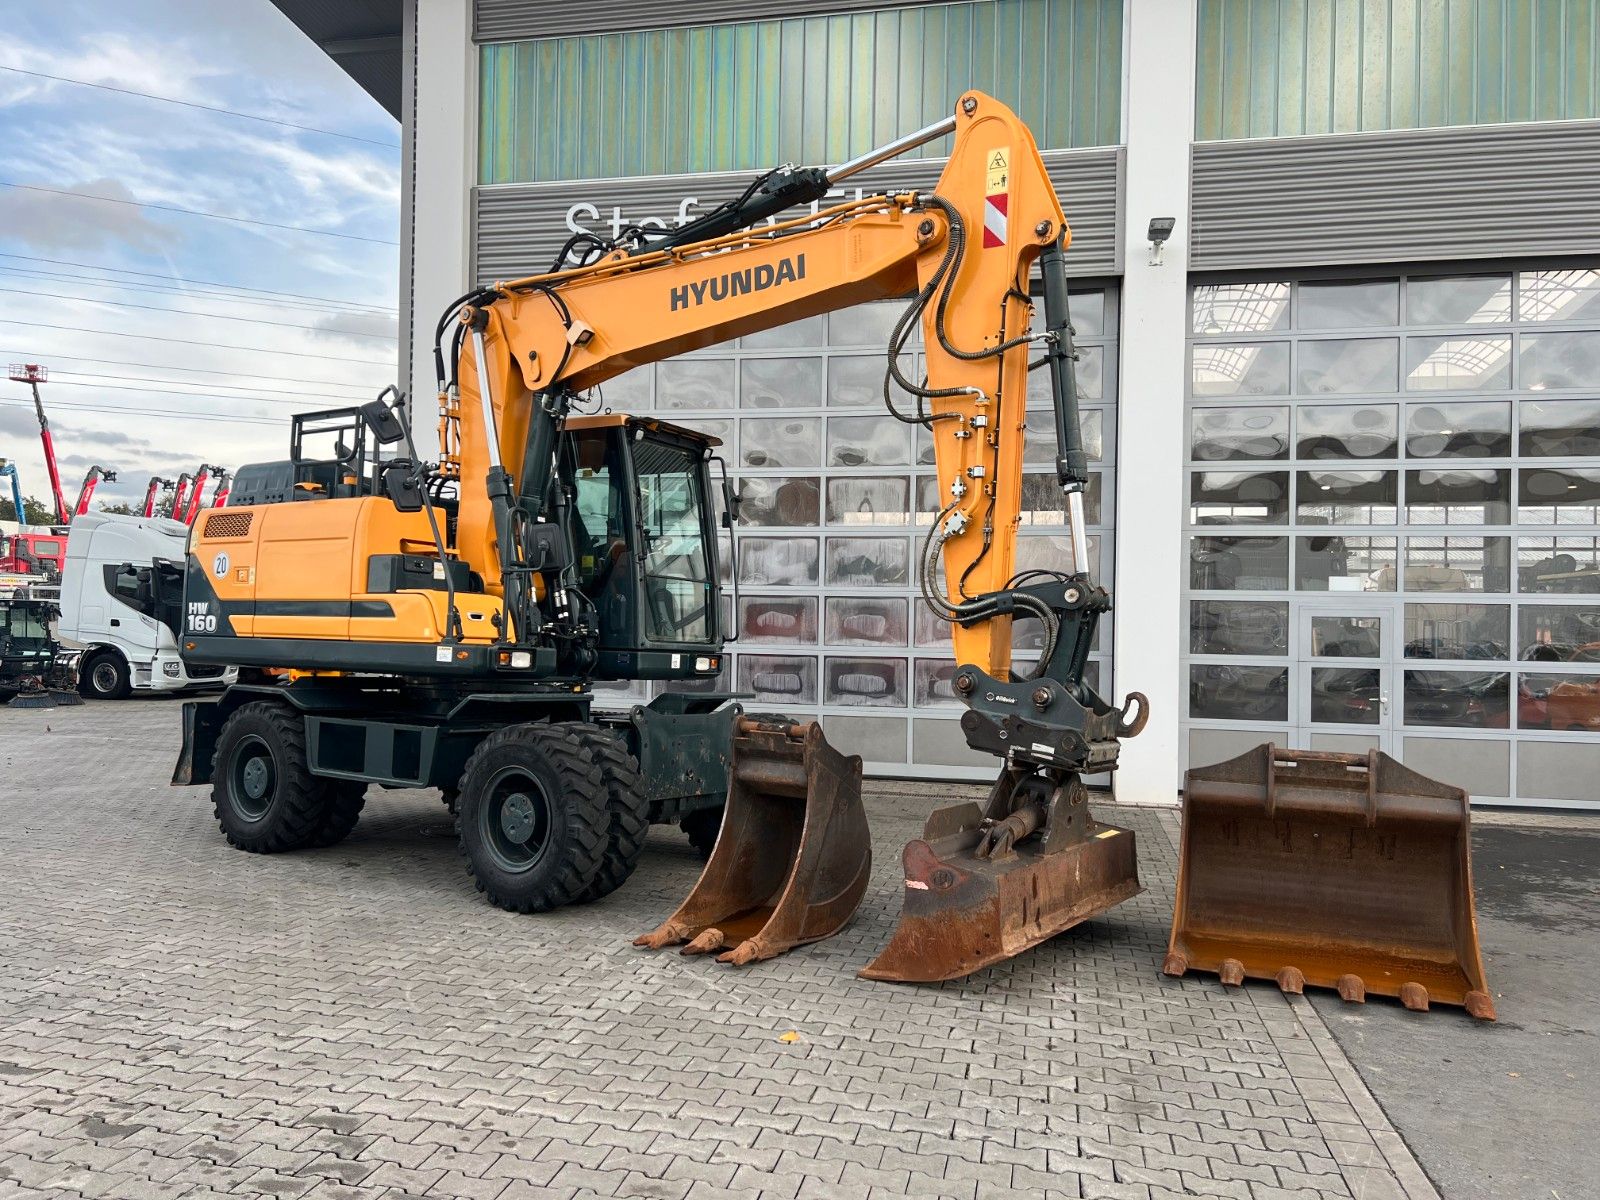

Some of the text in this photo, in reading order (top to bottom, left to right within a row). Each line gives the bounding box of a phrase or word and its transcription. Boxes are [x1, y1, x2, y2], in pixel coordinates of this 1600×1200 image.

[670, 253, 806, 312] HYUNDAI
[216, 557, 227, 574] 20
[188, 602, 209, 615] HW
[187, 614, 217, 633] 160
